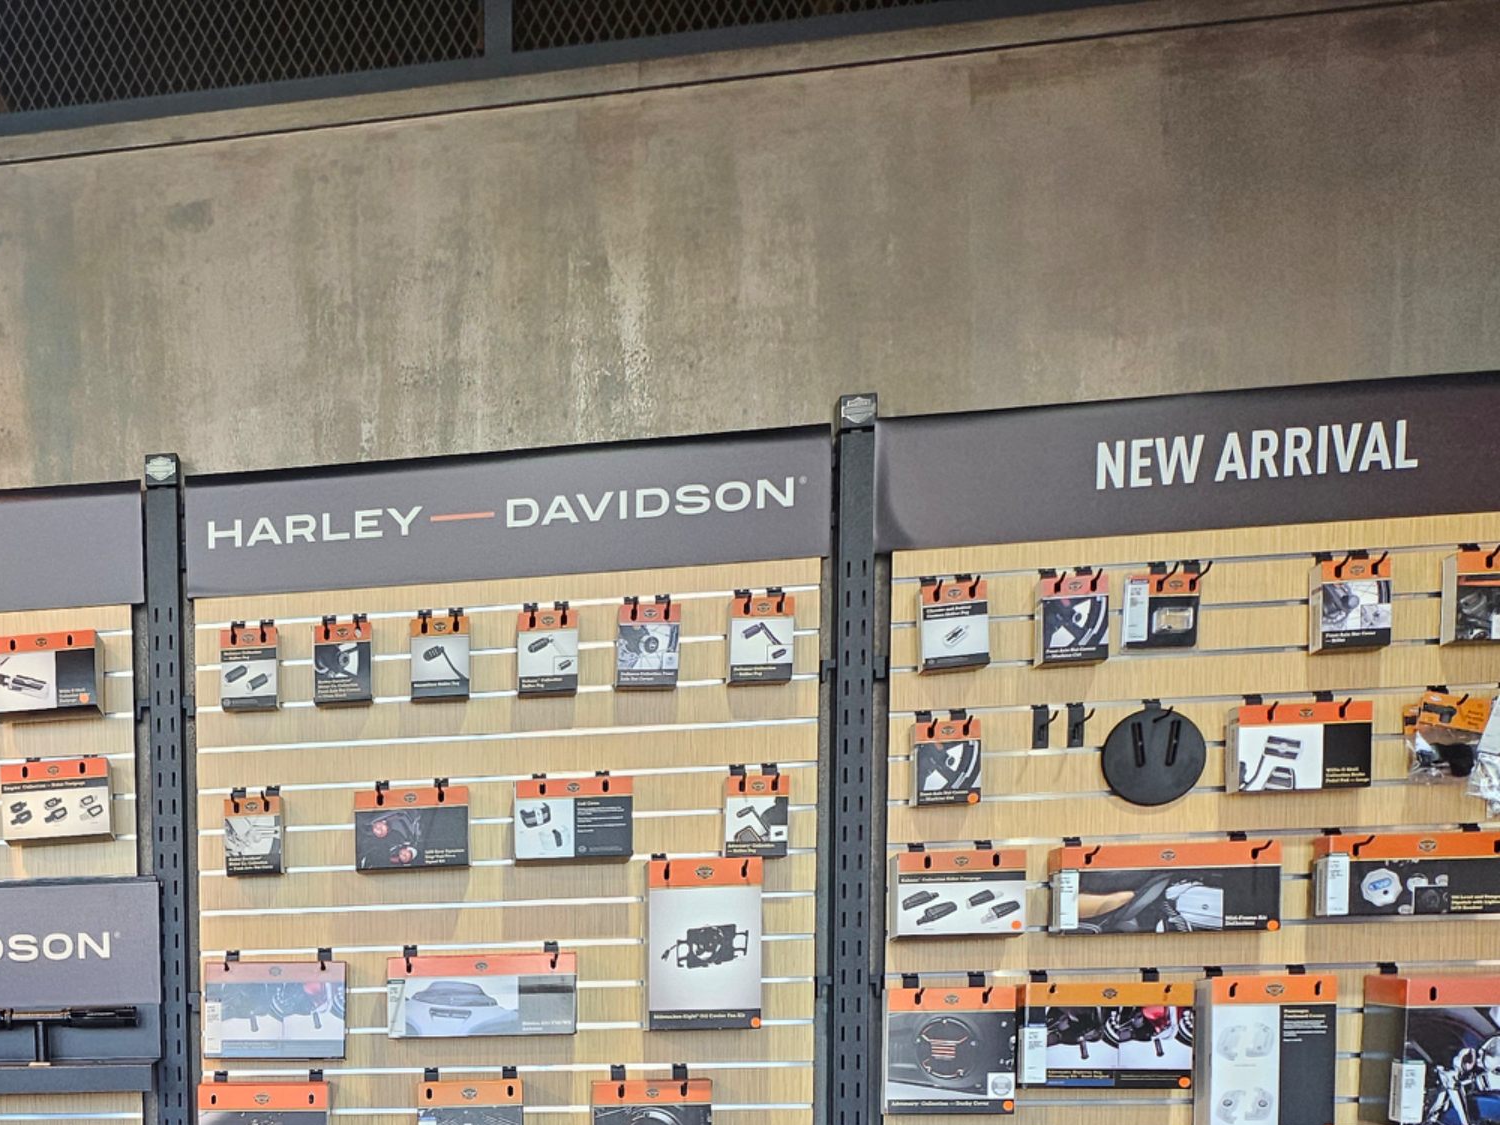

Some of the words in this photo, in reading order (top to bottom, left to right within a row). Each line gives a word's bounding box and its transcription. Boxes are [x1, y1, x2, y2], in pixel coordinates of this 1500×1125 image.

[1096, 434, 1204, 490] NEW
[1214, 419, 1418, 482] ARRIVAL
[207, 505, 423, 549] HARLEY
[506, 476, 795, 528] DAVIDSON
